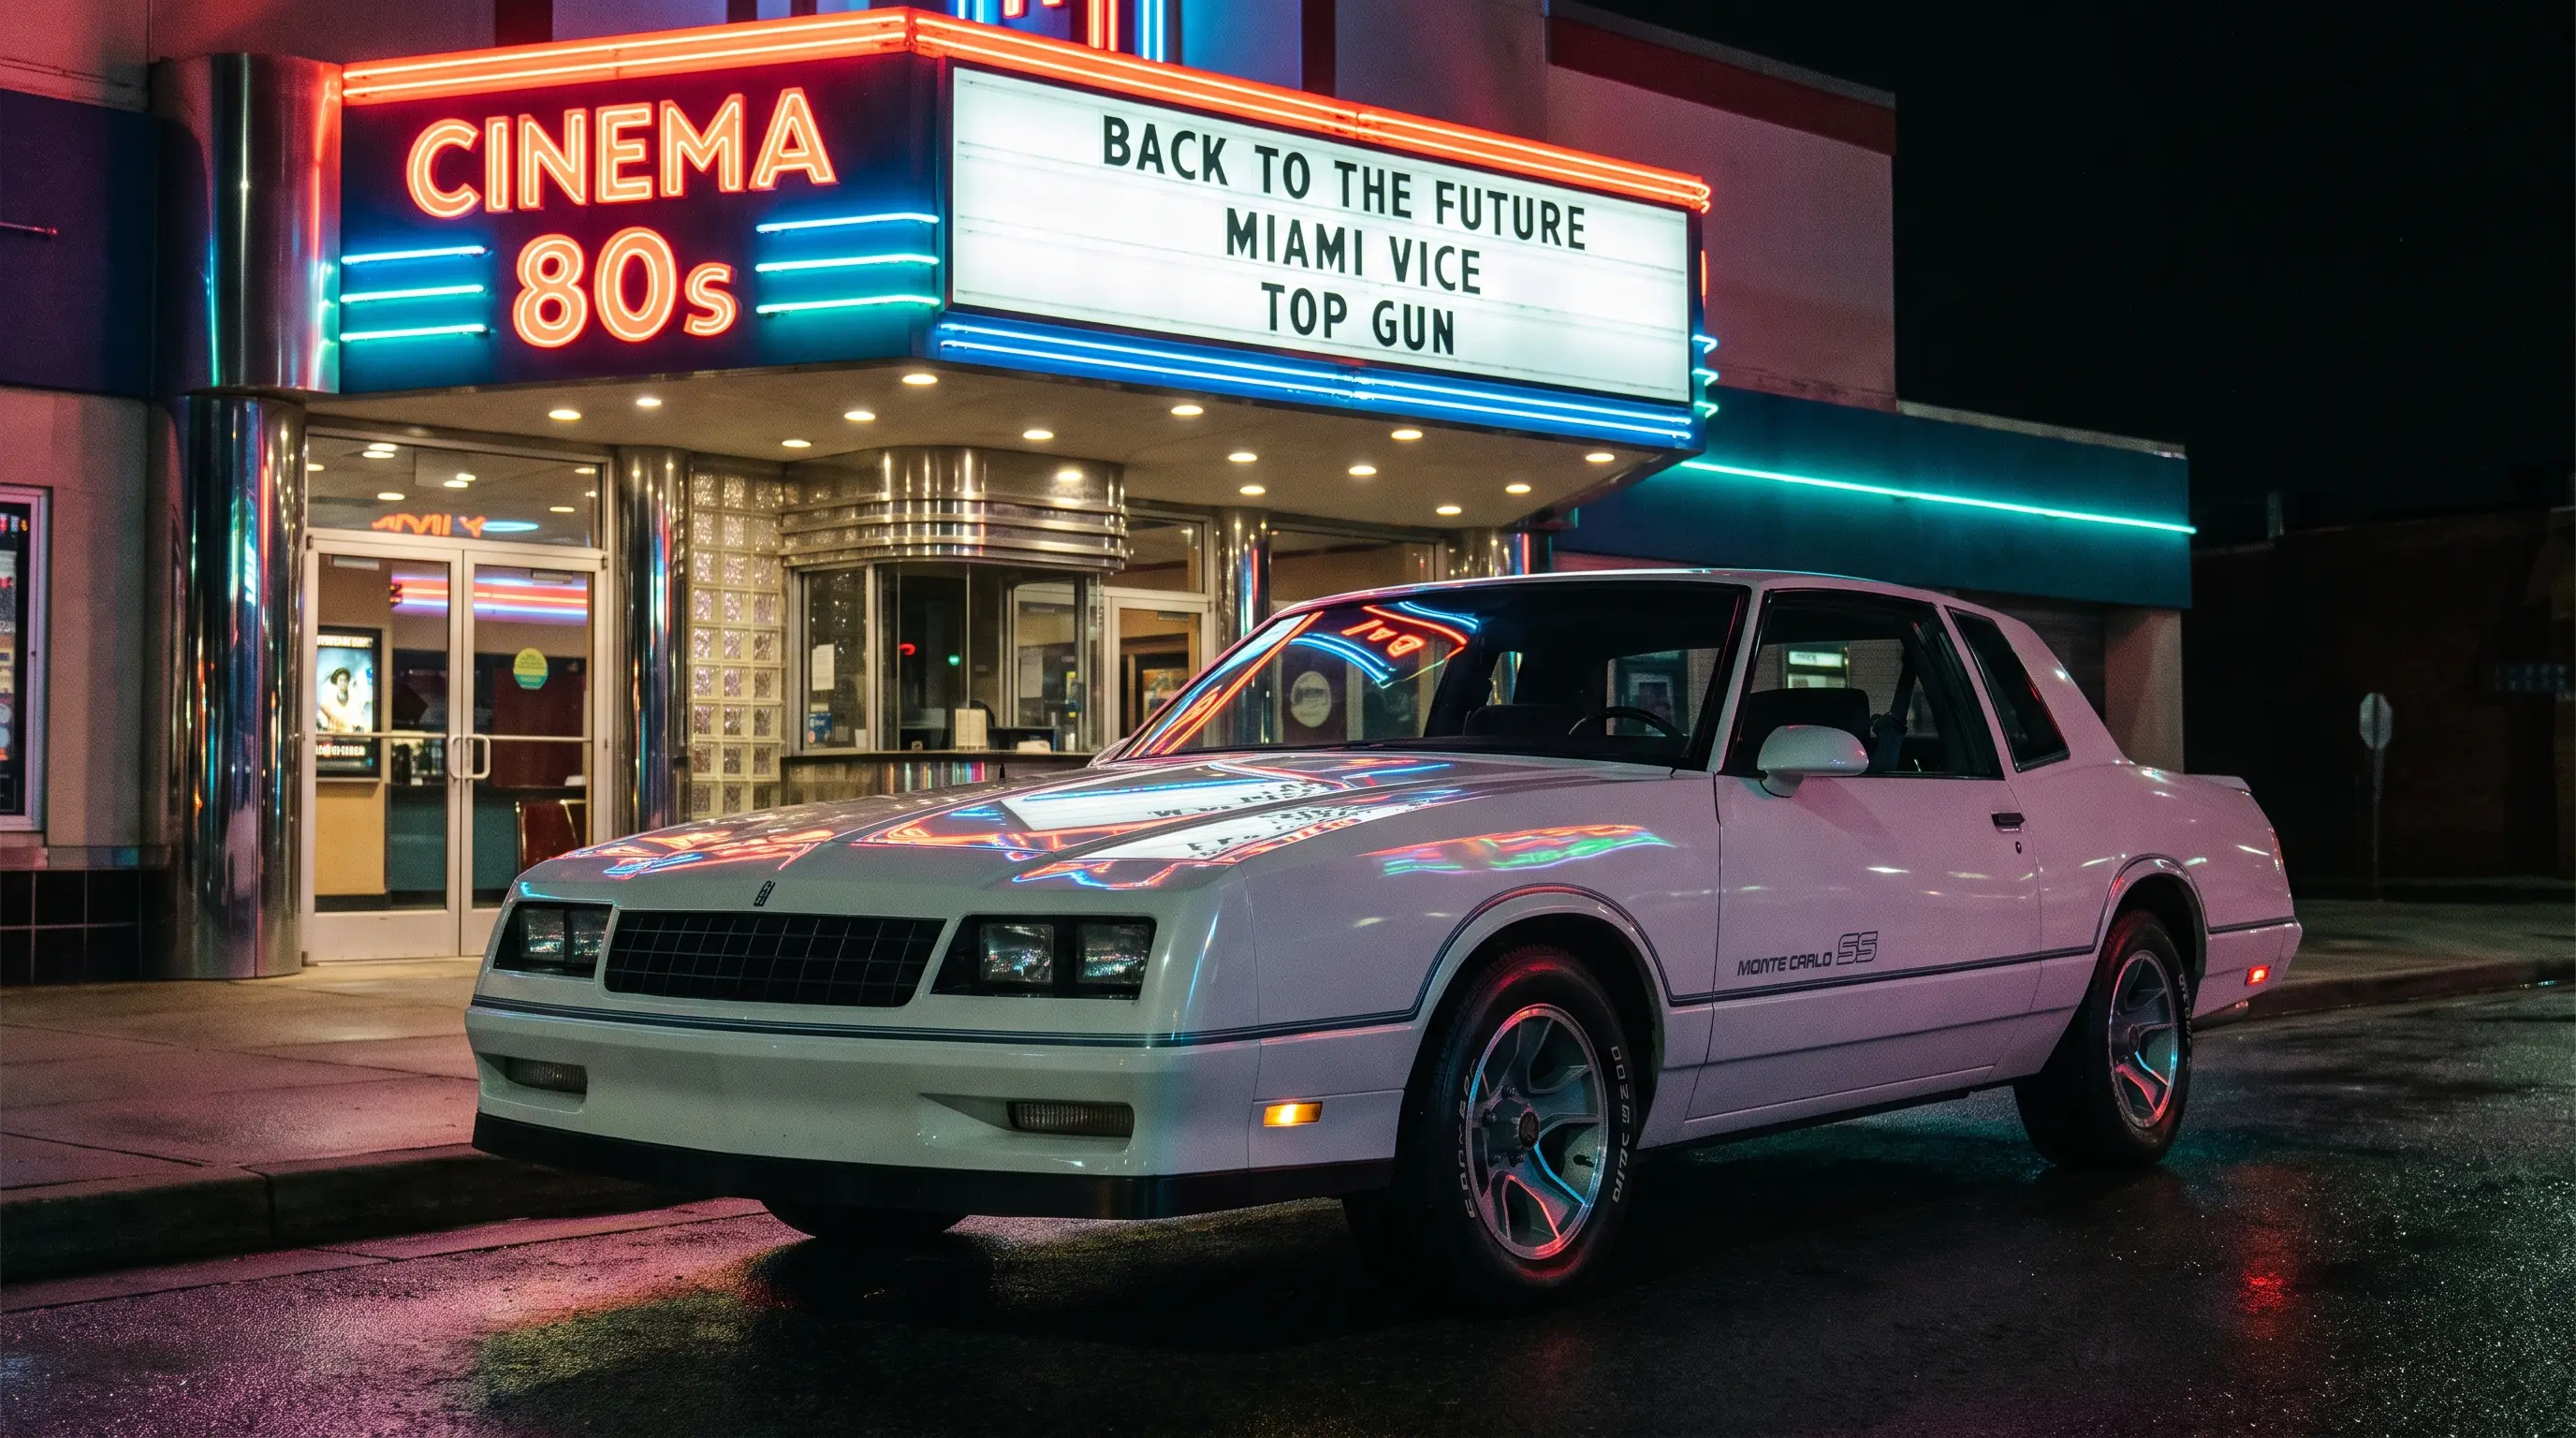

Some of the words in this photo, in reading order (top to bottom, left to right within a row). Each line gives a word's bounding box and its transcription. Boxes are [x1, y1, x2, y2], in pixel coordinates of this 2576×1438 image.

[405, 86, 838, 219] CINEMA
[1104, 114, 1228, 185] BACK
[1255, 144, 1310, 199] TO
[1335, 159, 1412, 219] THE
[1436, 180, 1585, 250] FUTURE
[512, 227, 739, 348] 80s
[1227, 207, 1363, 276] MIAMI
[1389, 236, 1481, 295] VICE
[1261, 282, 1348, 339] TOP
[1372, 300, 1454, 355] GUN
[1737, 956, 1788, 976] MONTE
[1789, 951, 1833, 971] CARLO
[1837, 931, 1879, 966] SS
